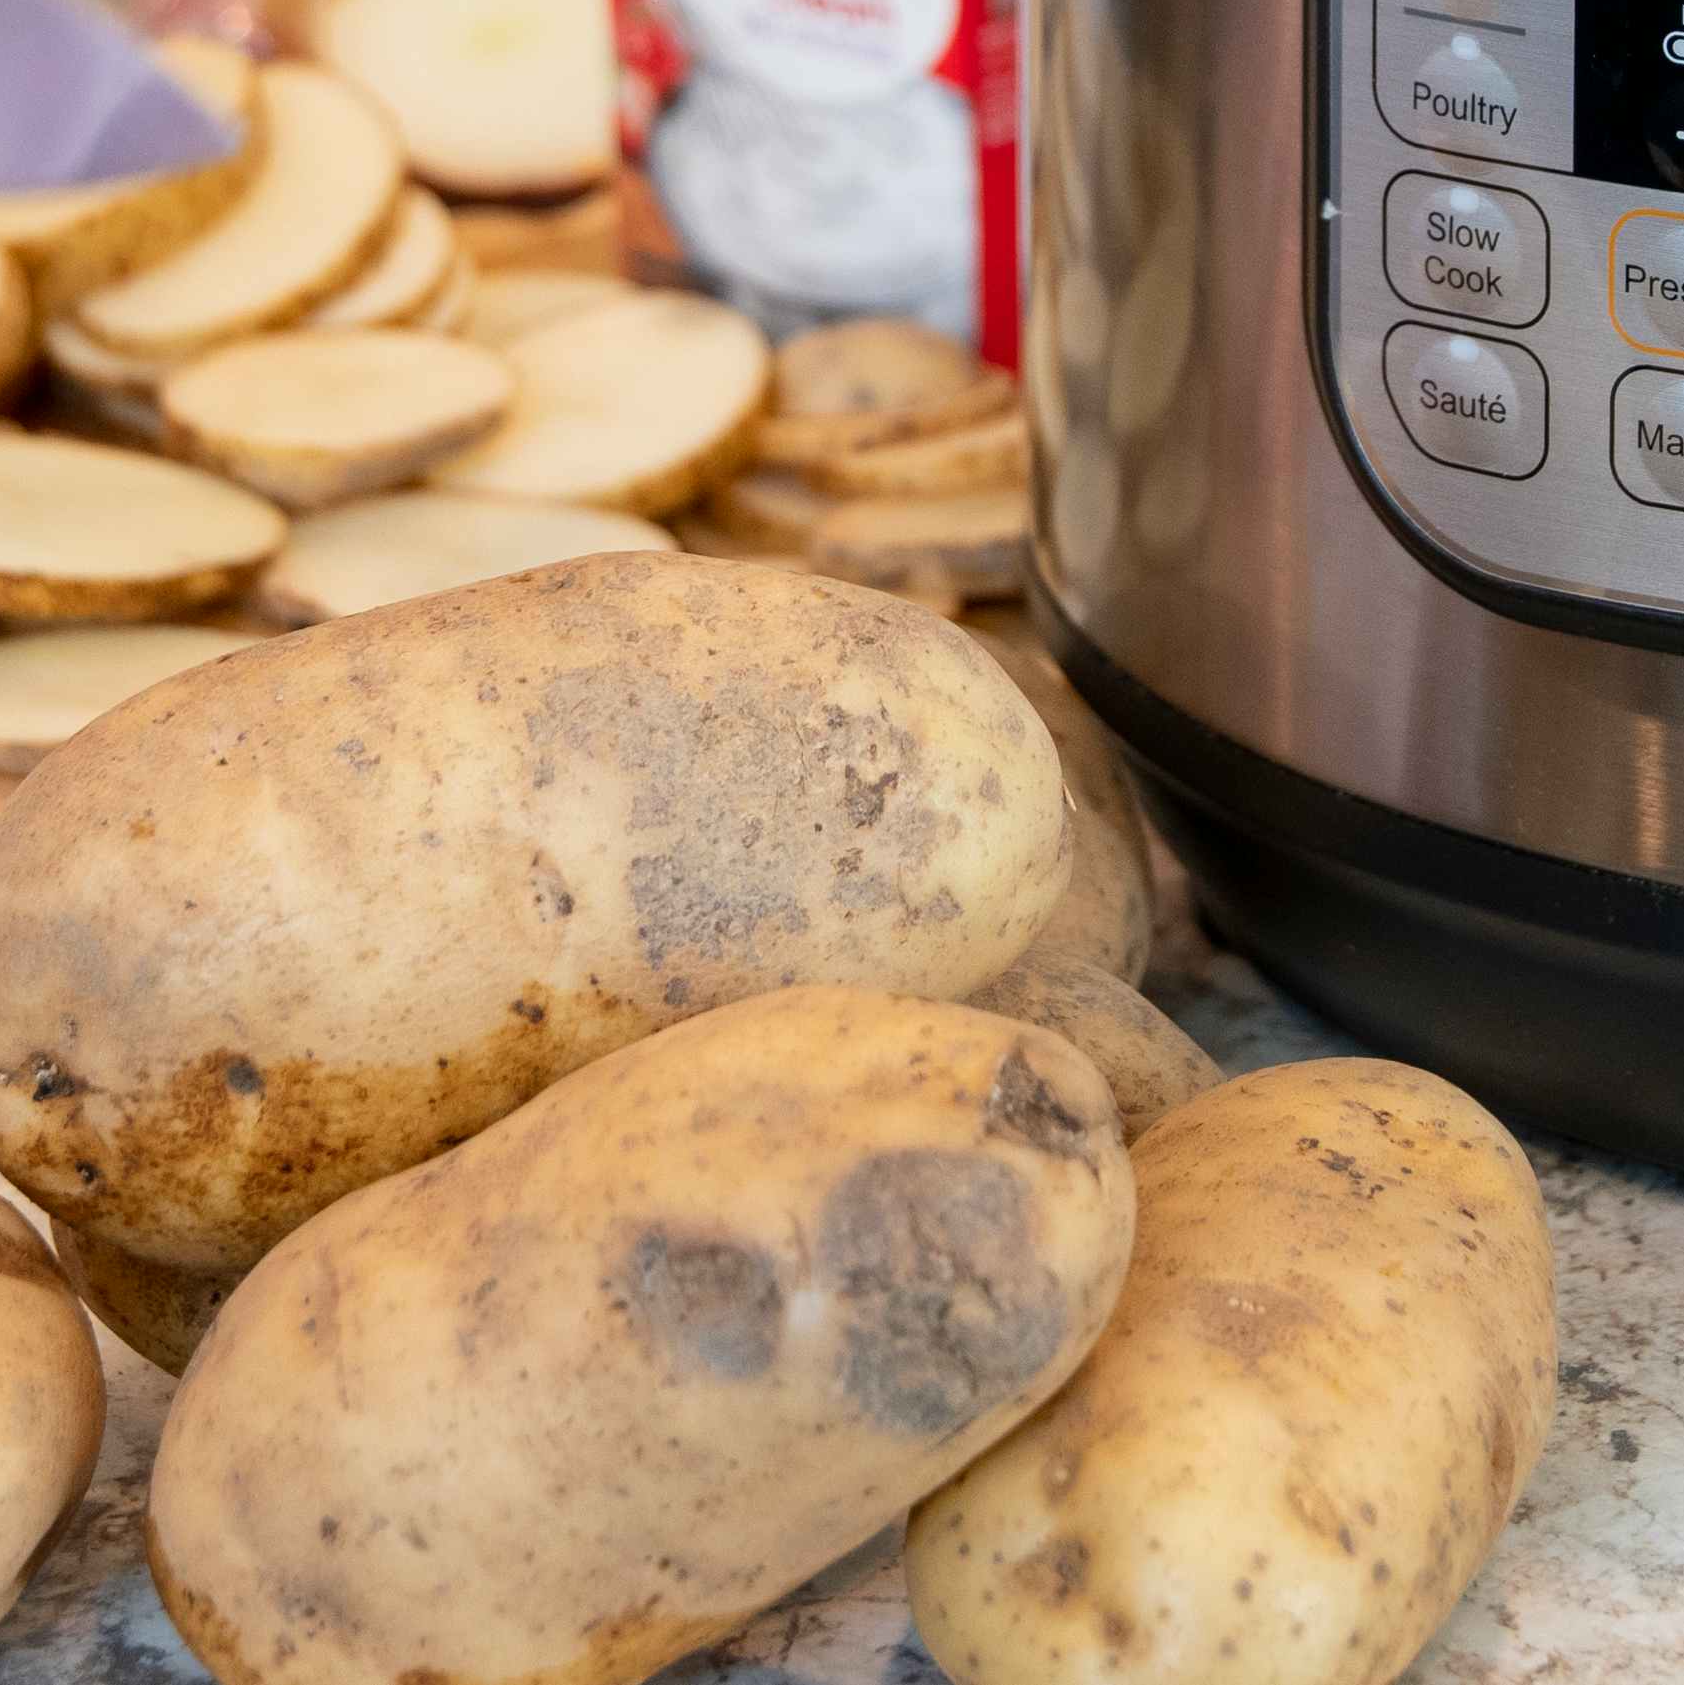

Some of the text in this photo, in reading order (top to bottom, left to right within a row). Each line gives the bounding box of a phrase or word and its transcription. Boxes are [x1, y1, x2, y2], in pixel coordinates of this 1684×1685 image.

[1414, 82, 1517, 135] Poultry
[1427, 212, 1500, 252] Slow
[1425, 256, 1503, 297] Cook
[1420, 379, 1506, 423] Sauté
